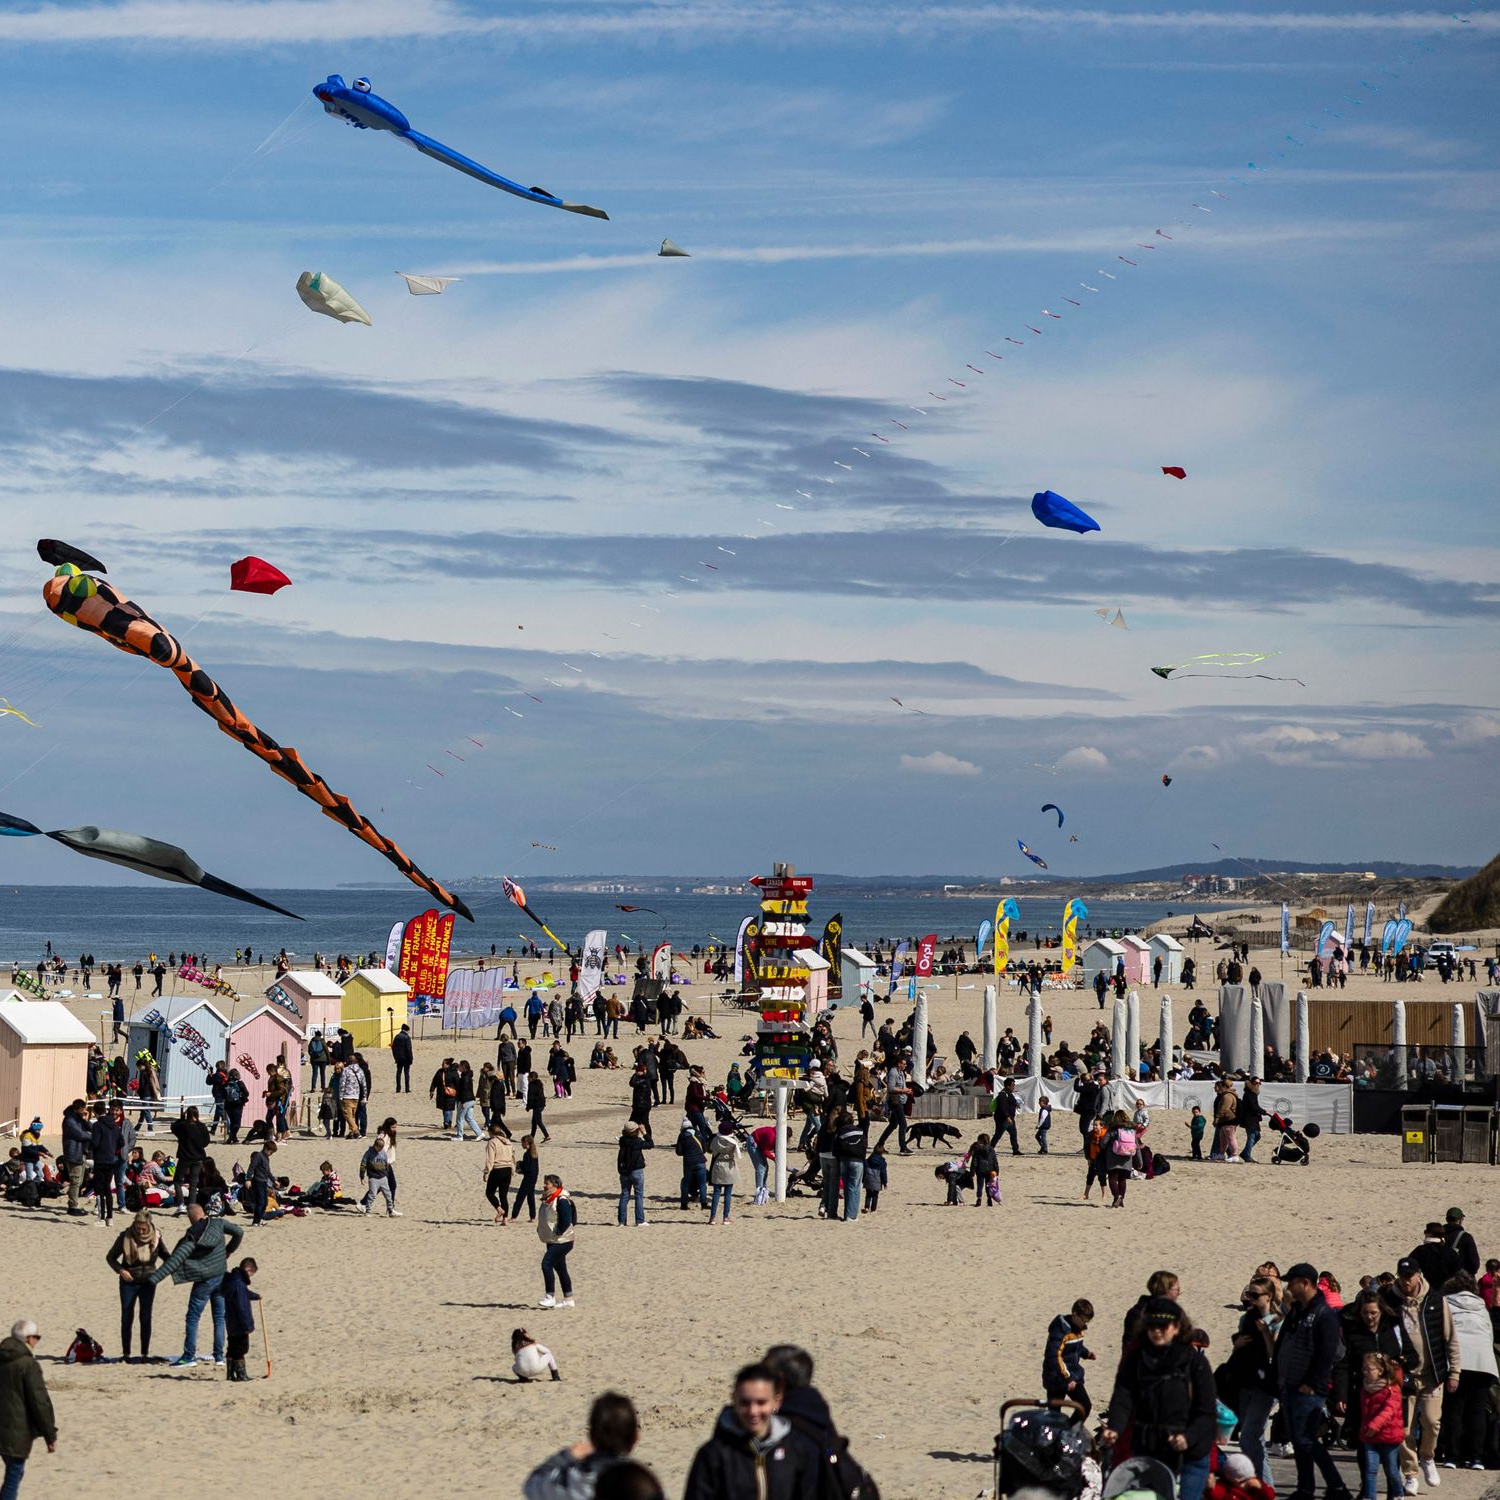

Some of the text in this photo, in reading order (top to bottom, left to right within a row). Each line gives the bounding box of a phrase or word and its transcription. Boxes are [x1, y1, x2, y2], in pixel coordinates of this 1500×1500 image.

[412, 923, 422, 956] FRANCE
[419, 916, 434, 991] CLUB DE FRANCE
[410, 961, 418, 973] DE
[436, 921, 453, 996] CLUB DE FRANCE
[919, 944, 933, 970] Orpi
[761, 1058, 780, 1066] UKRAINE
